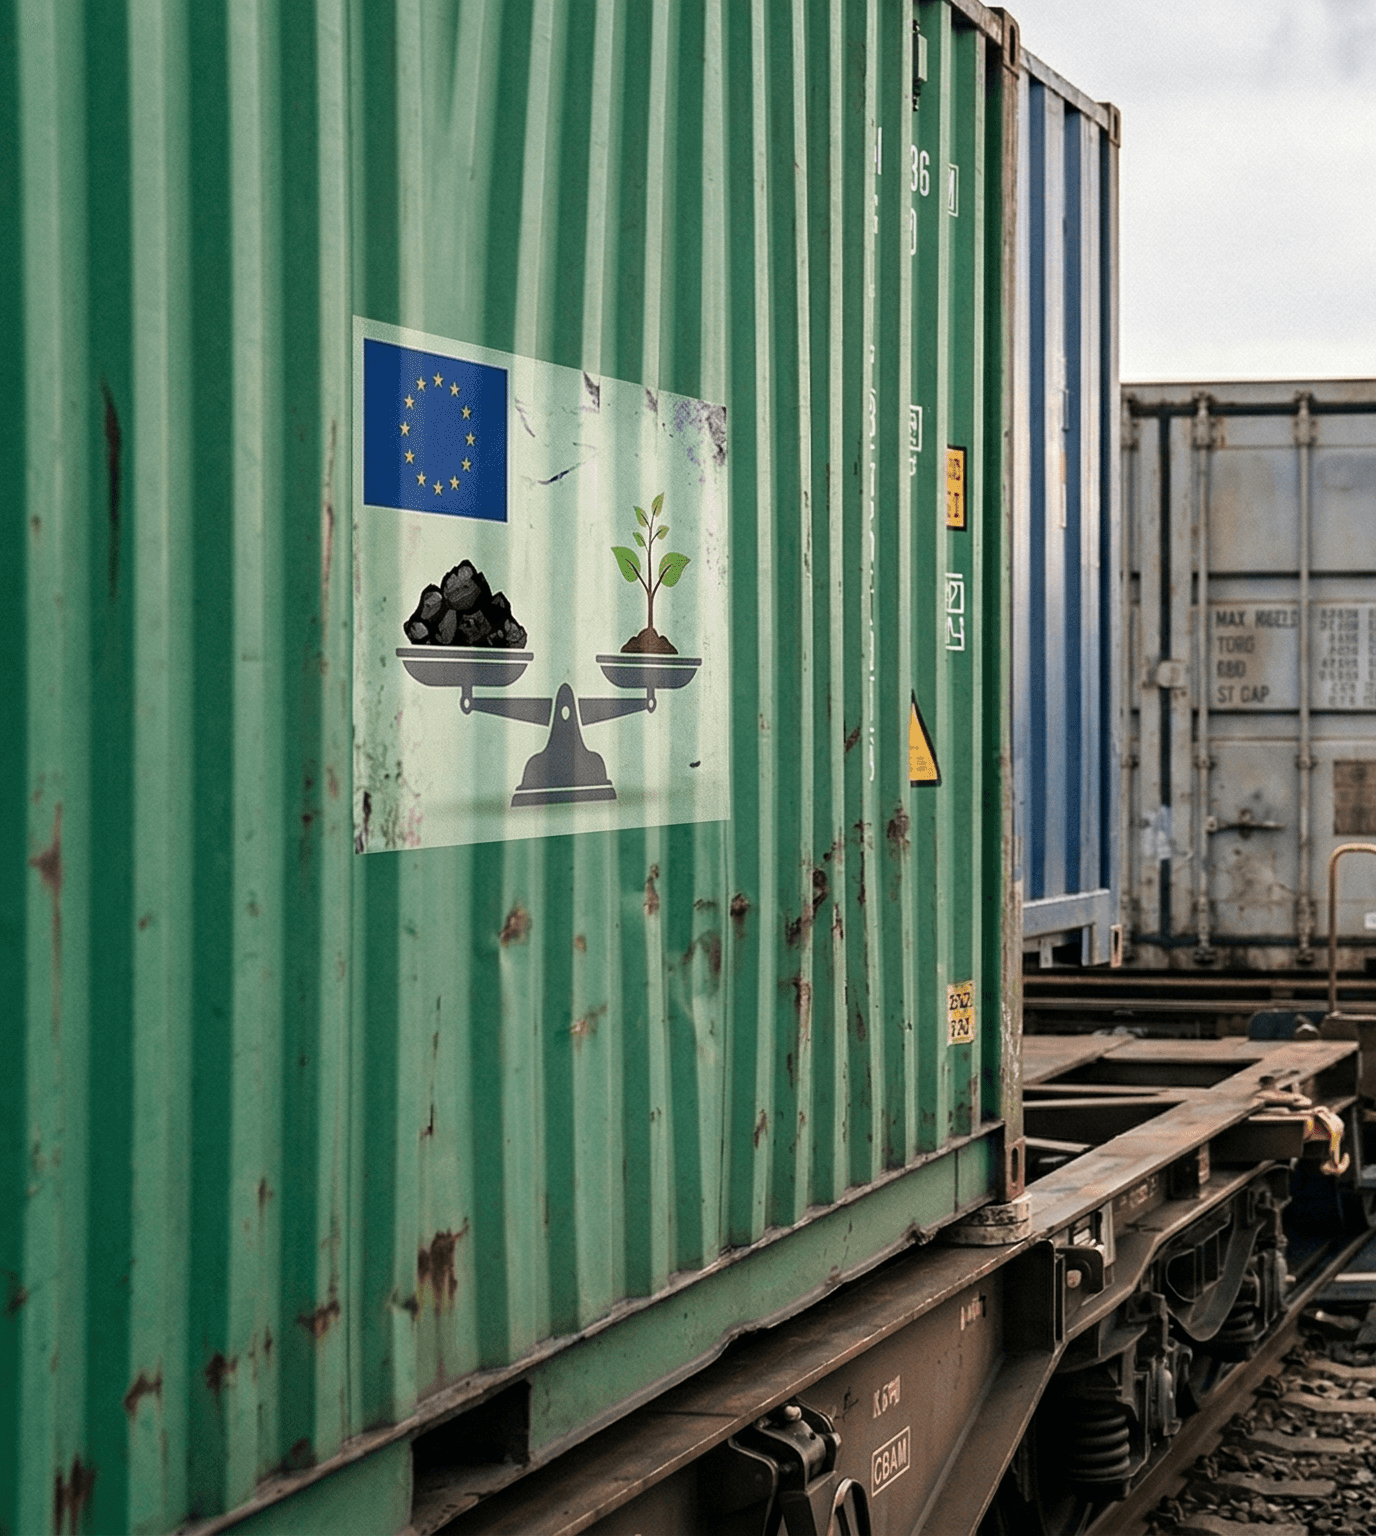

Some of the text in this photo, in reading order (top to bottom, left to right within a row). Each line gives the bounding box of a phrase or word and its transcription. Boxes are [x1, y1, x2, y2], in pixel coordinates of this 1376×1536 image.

[1216, 610, 1246, 629] MAX
[1217, 685, 1235, 704] ST
[874, 1437, 907, 1485] CBAM
